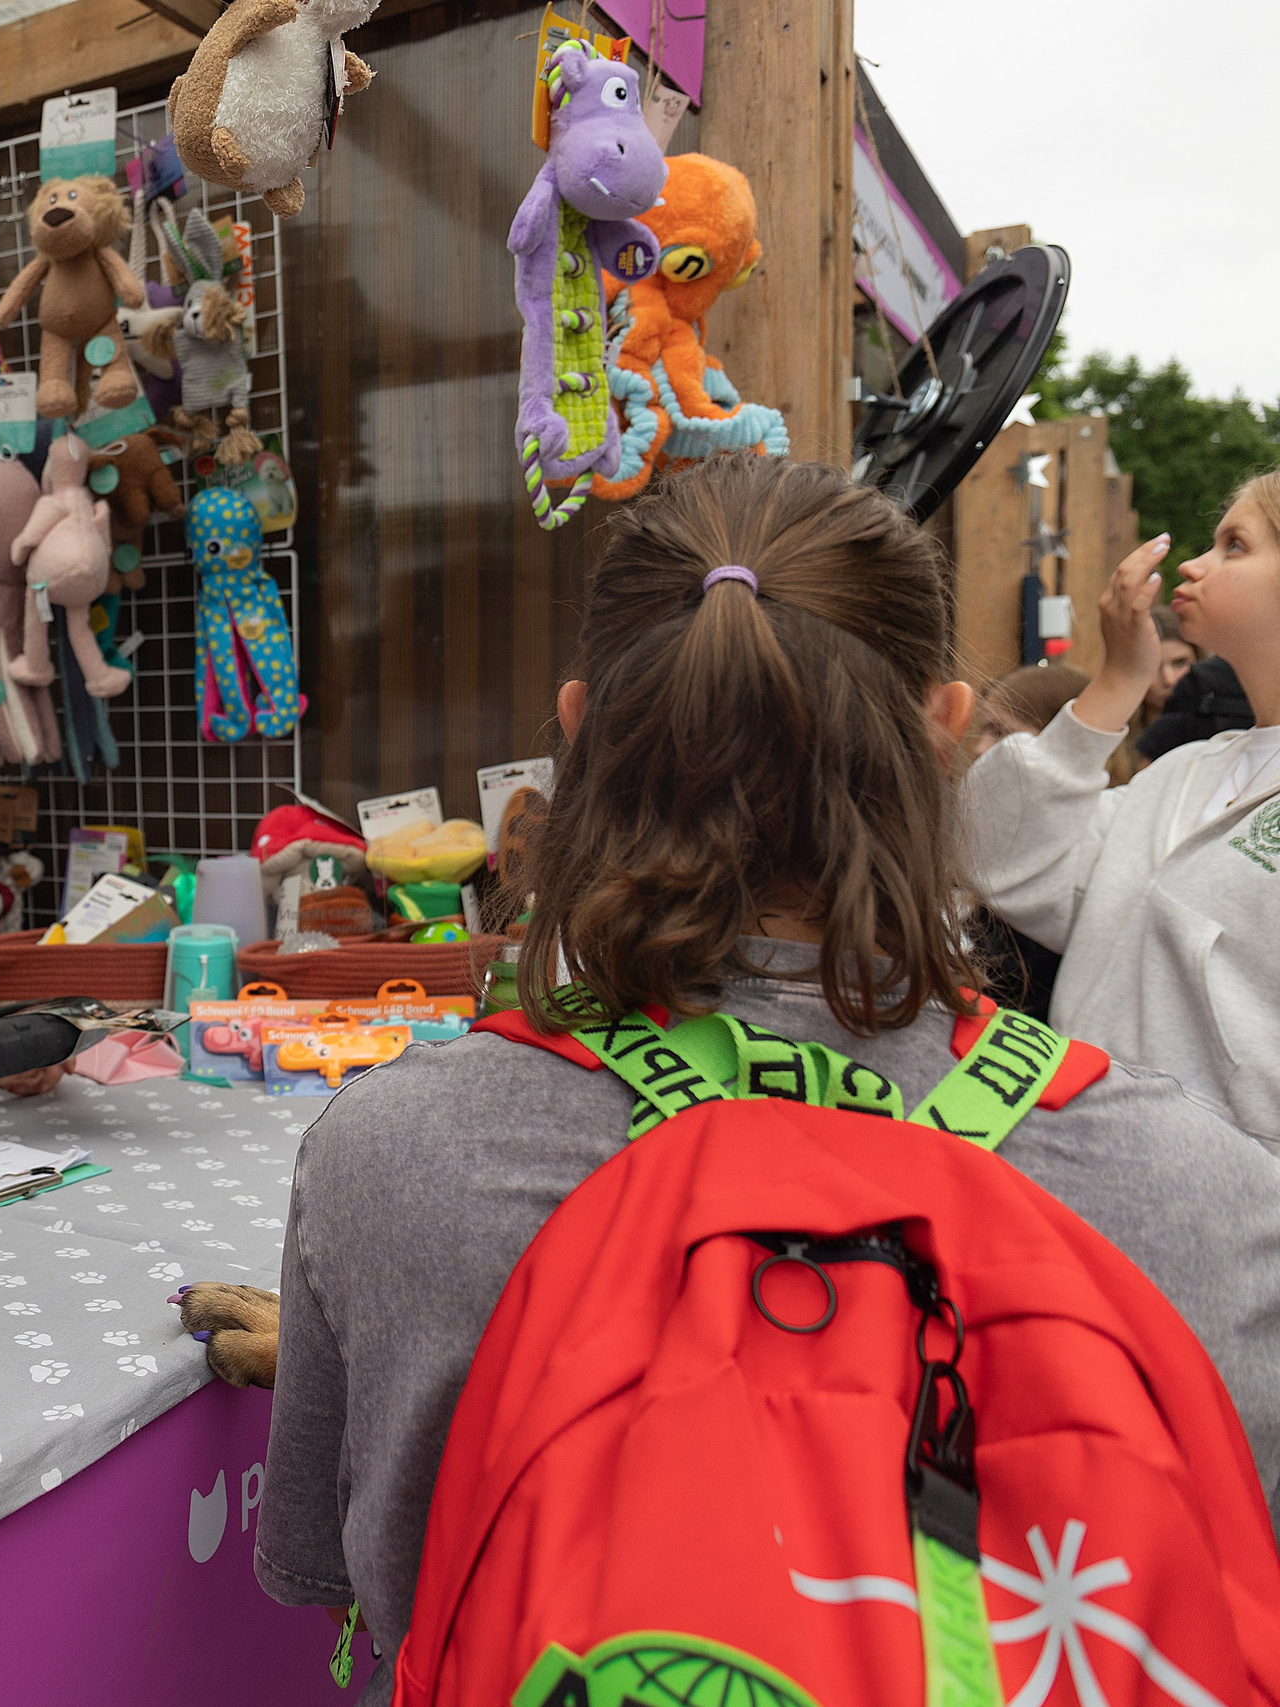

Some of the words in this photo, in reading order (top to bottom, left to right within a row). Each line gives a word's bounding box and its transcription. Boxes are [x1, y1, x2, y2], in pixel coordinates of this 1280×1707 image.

[196, 1005, 241, 1017] Schnappi
[244, 1005, 265, 1015] LED
[266, 1004, 296, 1016] Band
[335, 1004, 382, 1017] Schnappi
[383, 1004, 404, 1014] LED
[405, 1003, 434, 1015] Band
[267, 1030, 303, 1040] Schna
[580, 1020, 726, 1113] НЫХ
[963, 1013, 1058, 1109] ДЛЯ
